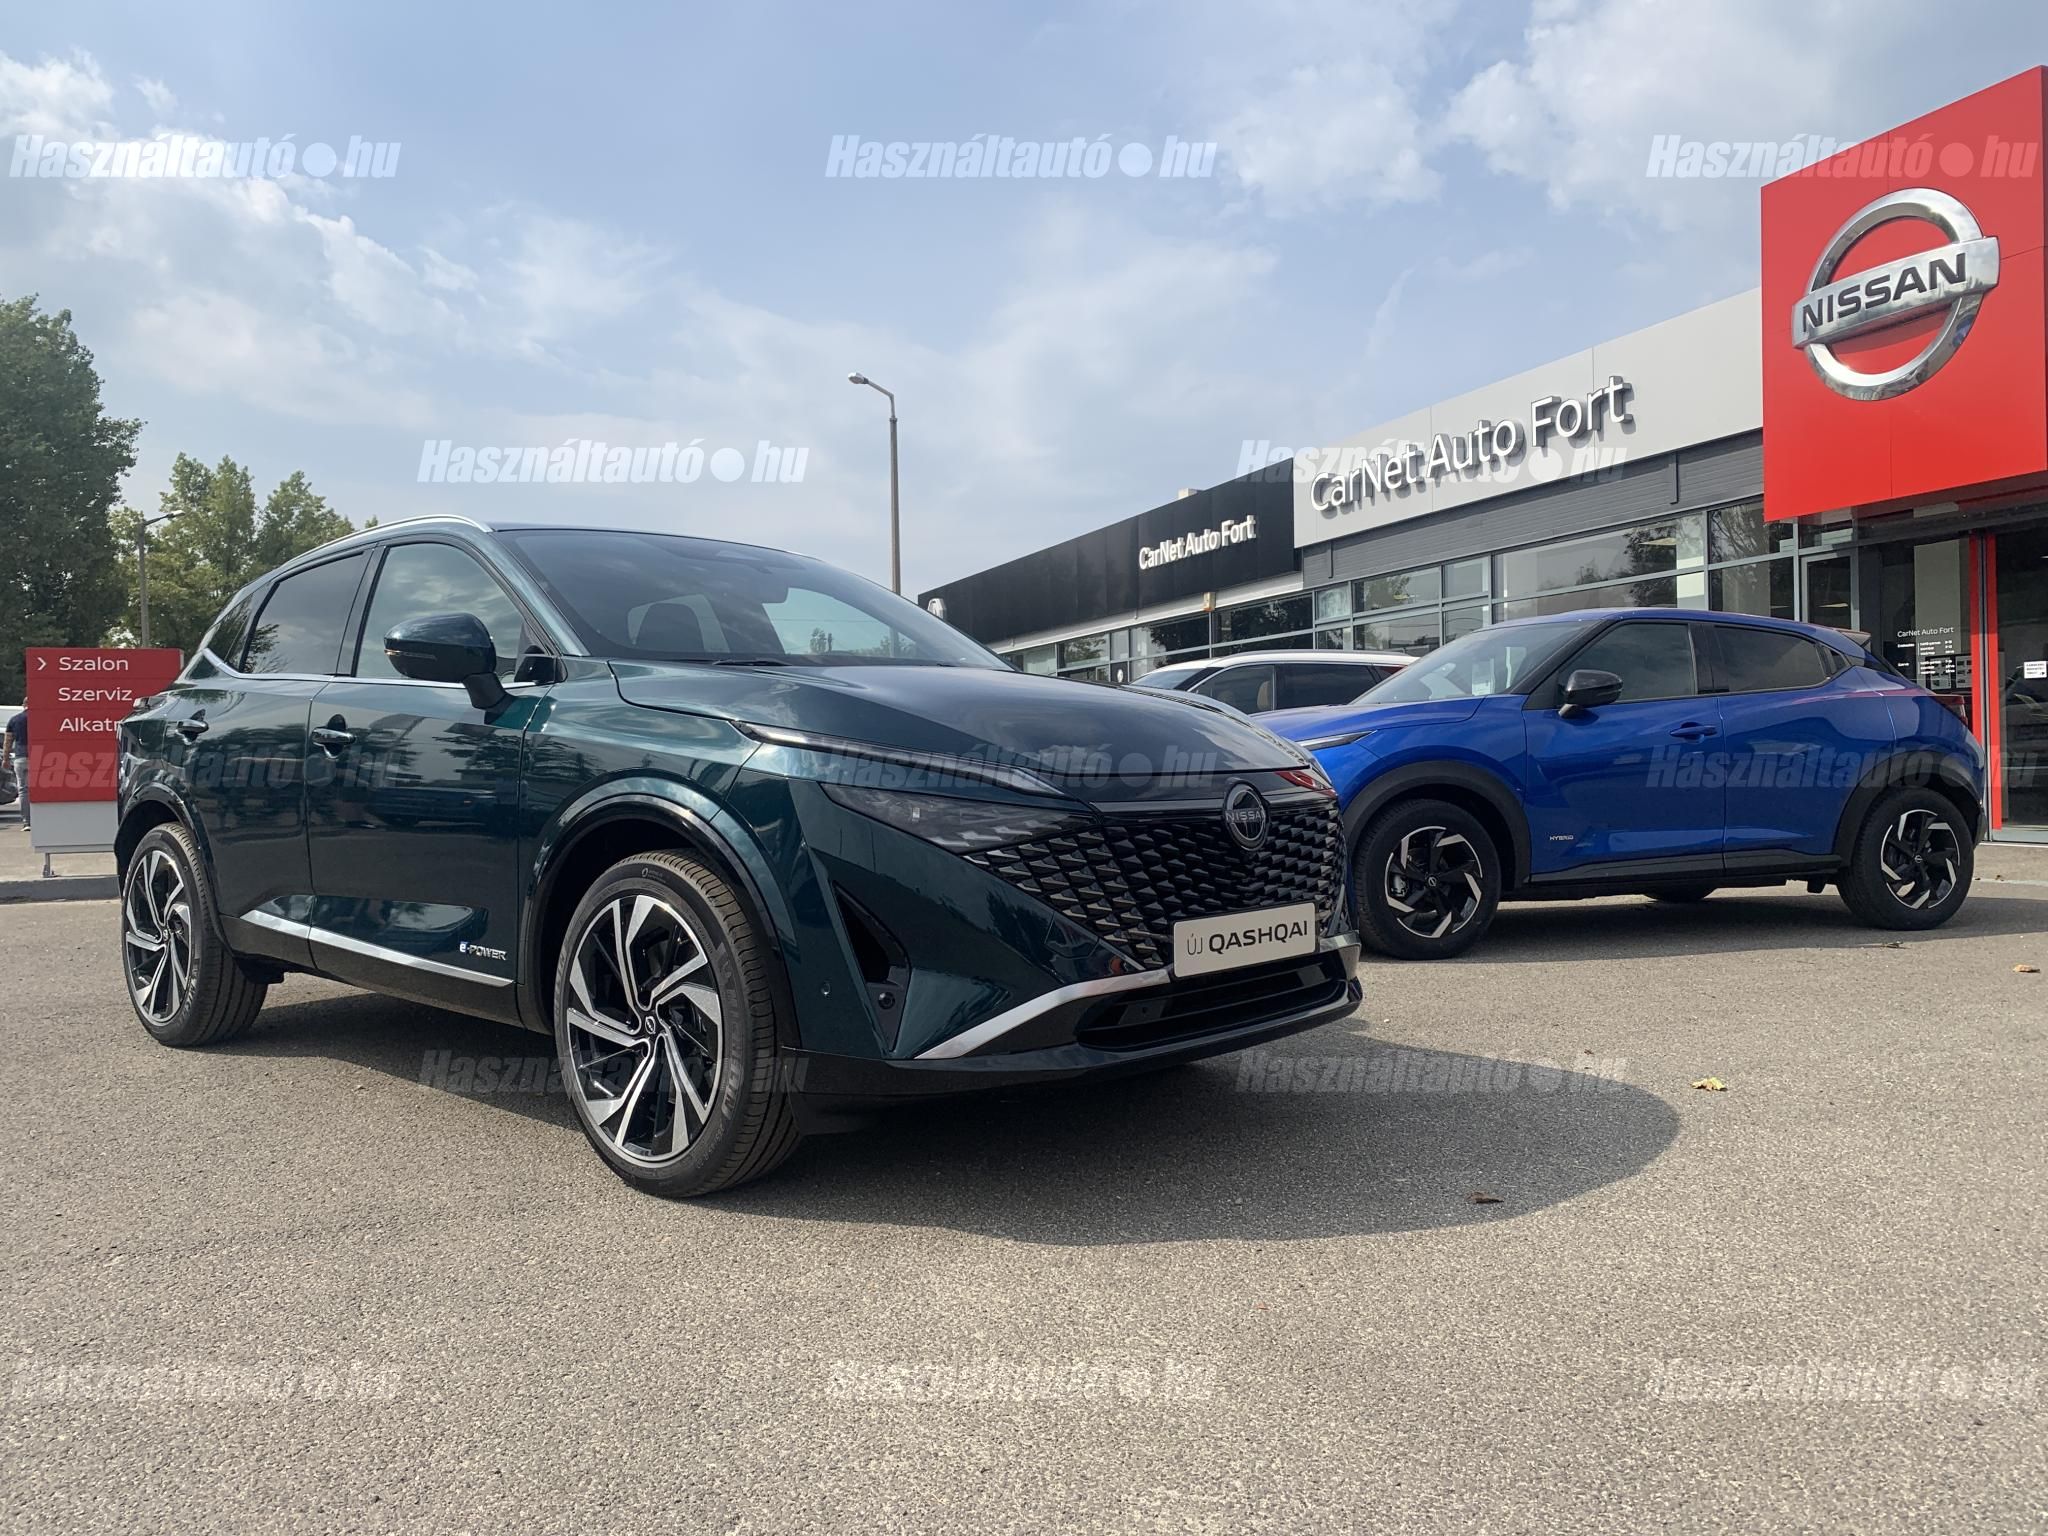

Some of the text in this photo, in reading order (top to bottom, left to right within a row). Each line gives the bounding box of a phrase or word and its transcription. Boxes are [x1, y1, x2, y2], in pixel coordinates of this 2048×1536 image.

[1801, 252, 1968, 333] NISSAN
[1310, 375, 1633, 512] CarNet Auto Fort
[1138, 514, 1257, 570] CarNet Auto Fort
[1897, 626, 1955, 638] CarNet Auto Fort
[58, 656, 129, 671] Szalon
[58, 687, 133, 702] Szerviz
[1225, 810, 1265, 822] NISSA
[1208, 920, 1308, 955] QASHQAI
